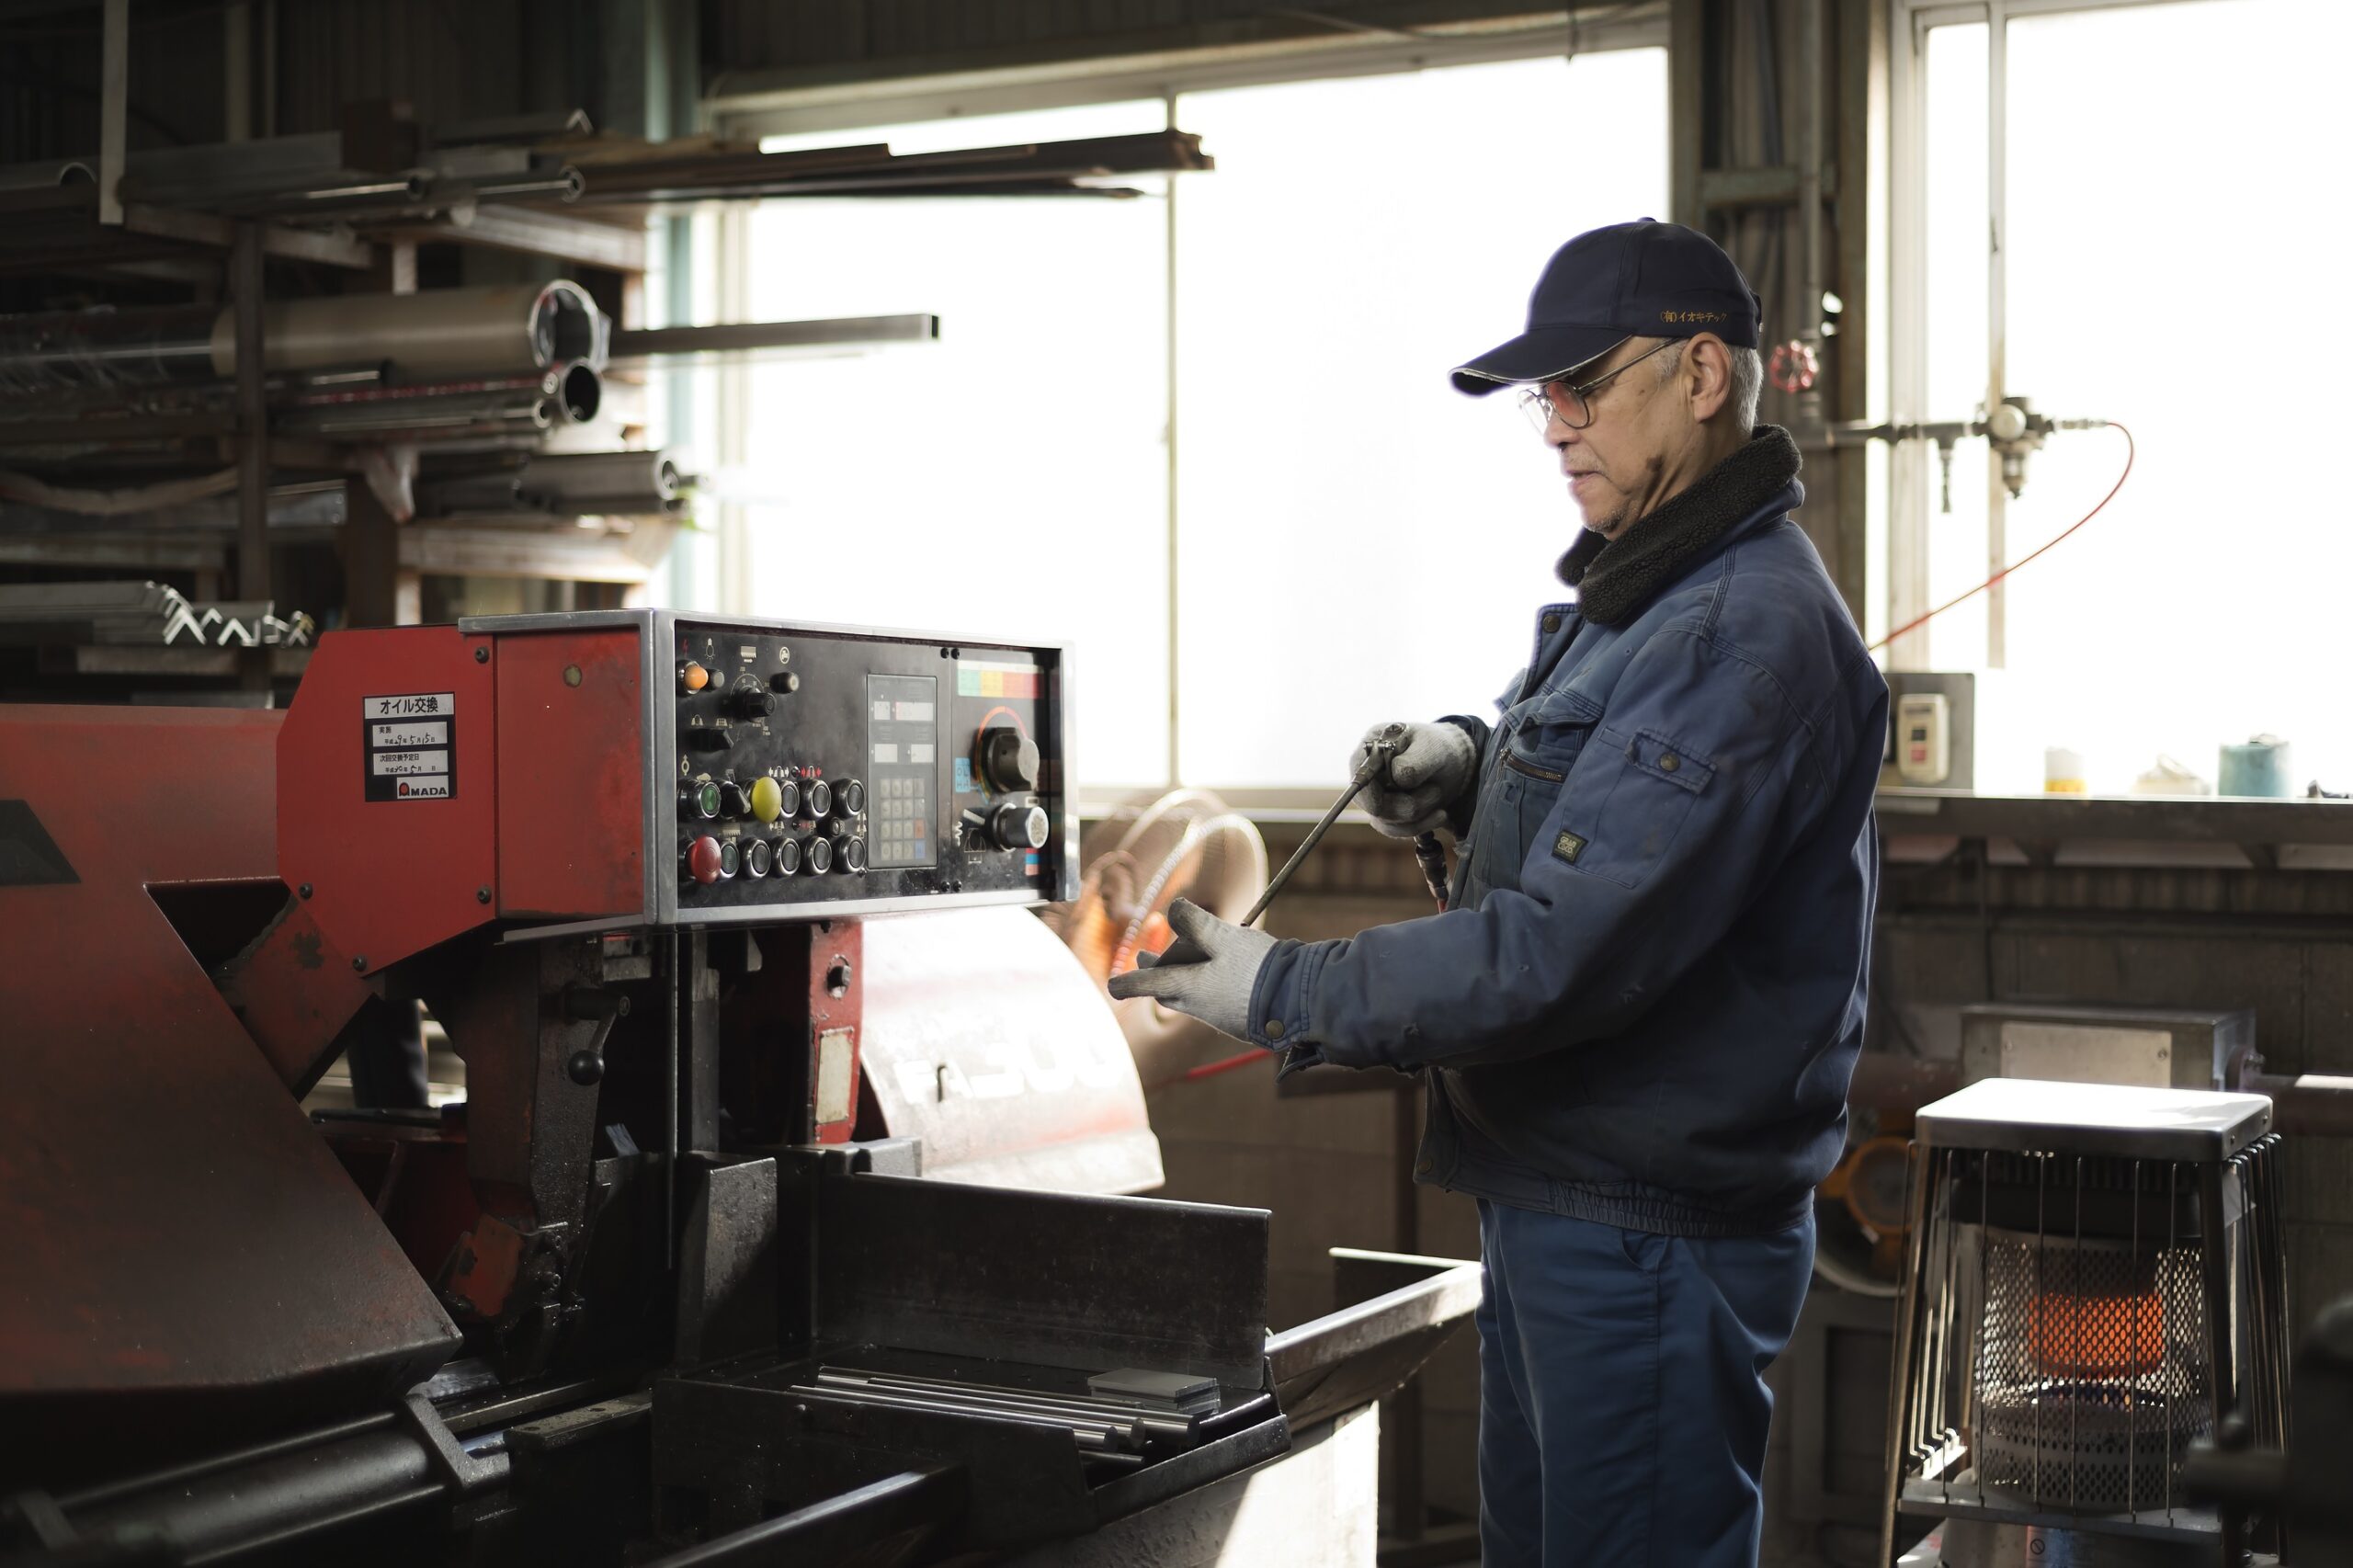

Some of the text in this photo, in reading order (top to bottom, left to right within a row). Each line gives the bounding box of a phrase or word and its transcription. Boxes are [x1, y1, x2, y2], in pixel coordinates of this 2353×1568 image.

[380, 696, 438, 715] オイル交換
[380, 753, 420, 762] 次回交換予定日
